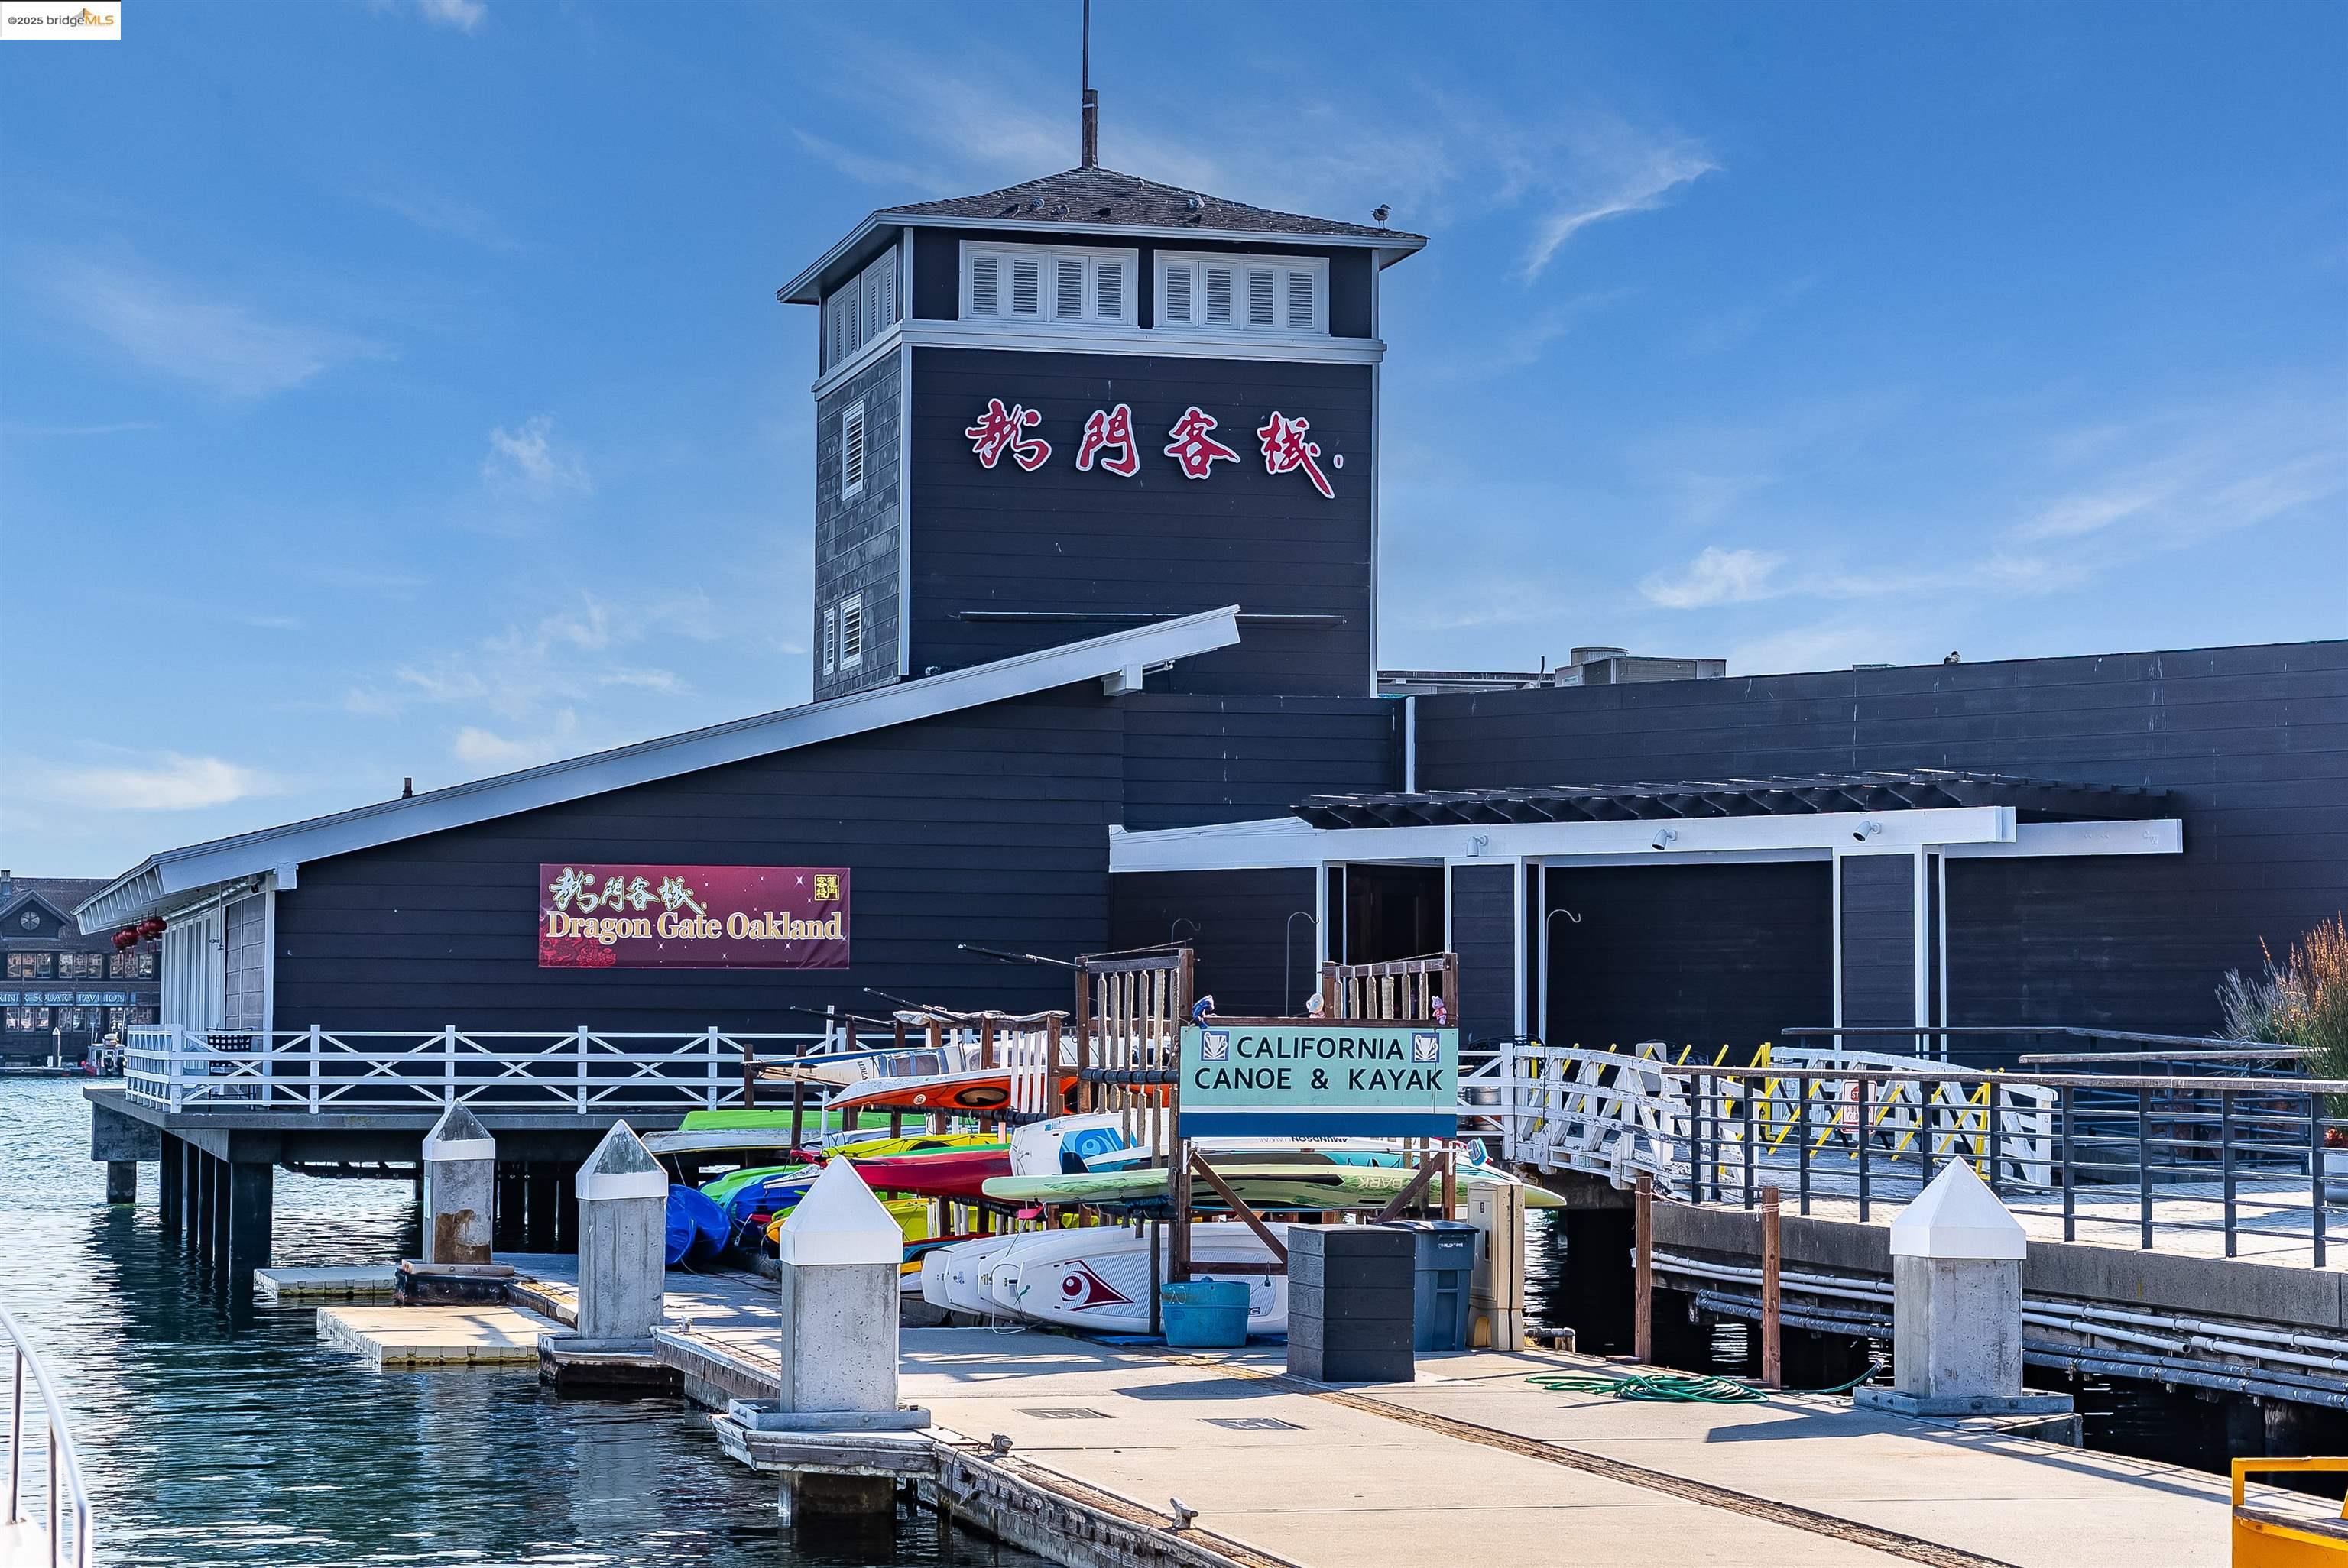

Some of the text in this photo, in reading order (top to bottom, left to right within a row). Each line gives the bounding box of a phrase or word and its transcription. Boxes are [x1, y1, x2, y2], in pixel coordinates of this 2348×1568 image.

[546, 911, 843, 945] Dragon Gate Oakland
[1237, 1036, 1404, 1061] CALIFORNIA
[1195, 1067, 1444, 1091] CANOE & KAYAK
[1357, 1177, 1403, 1189] BARK
